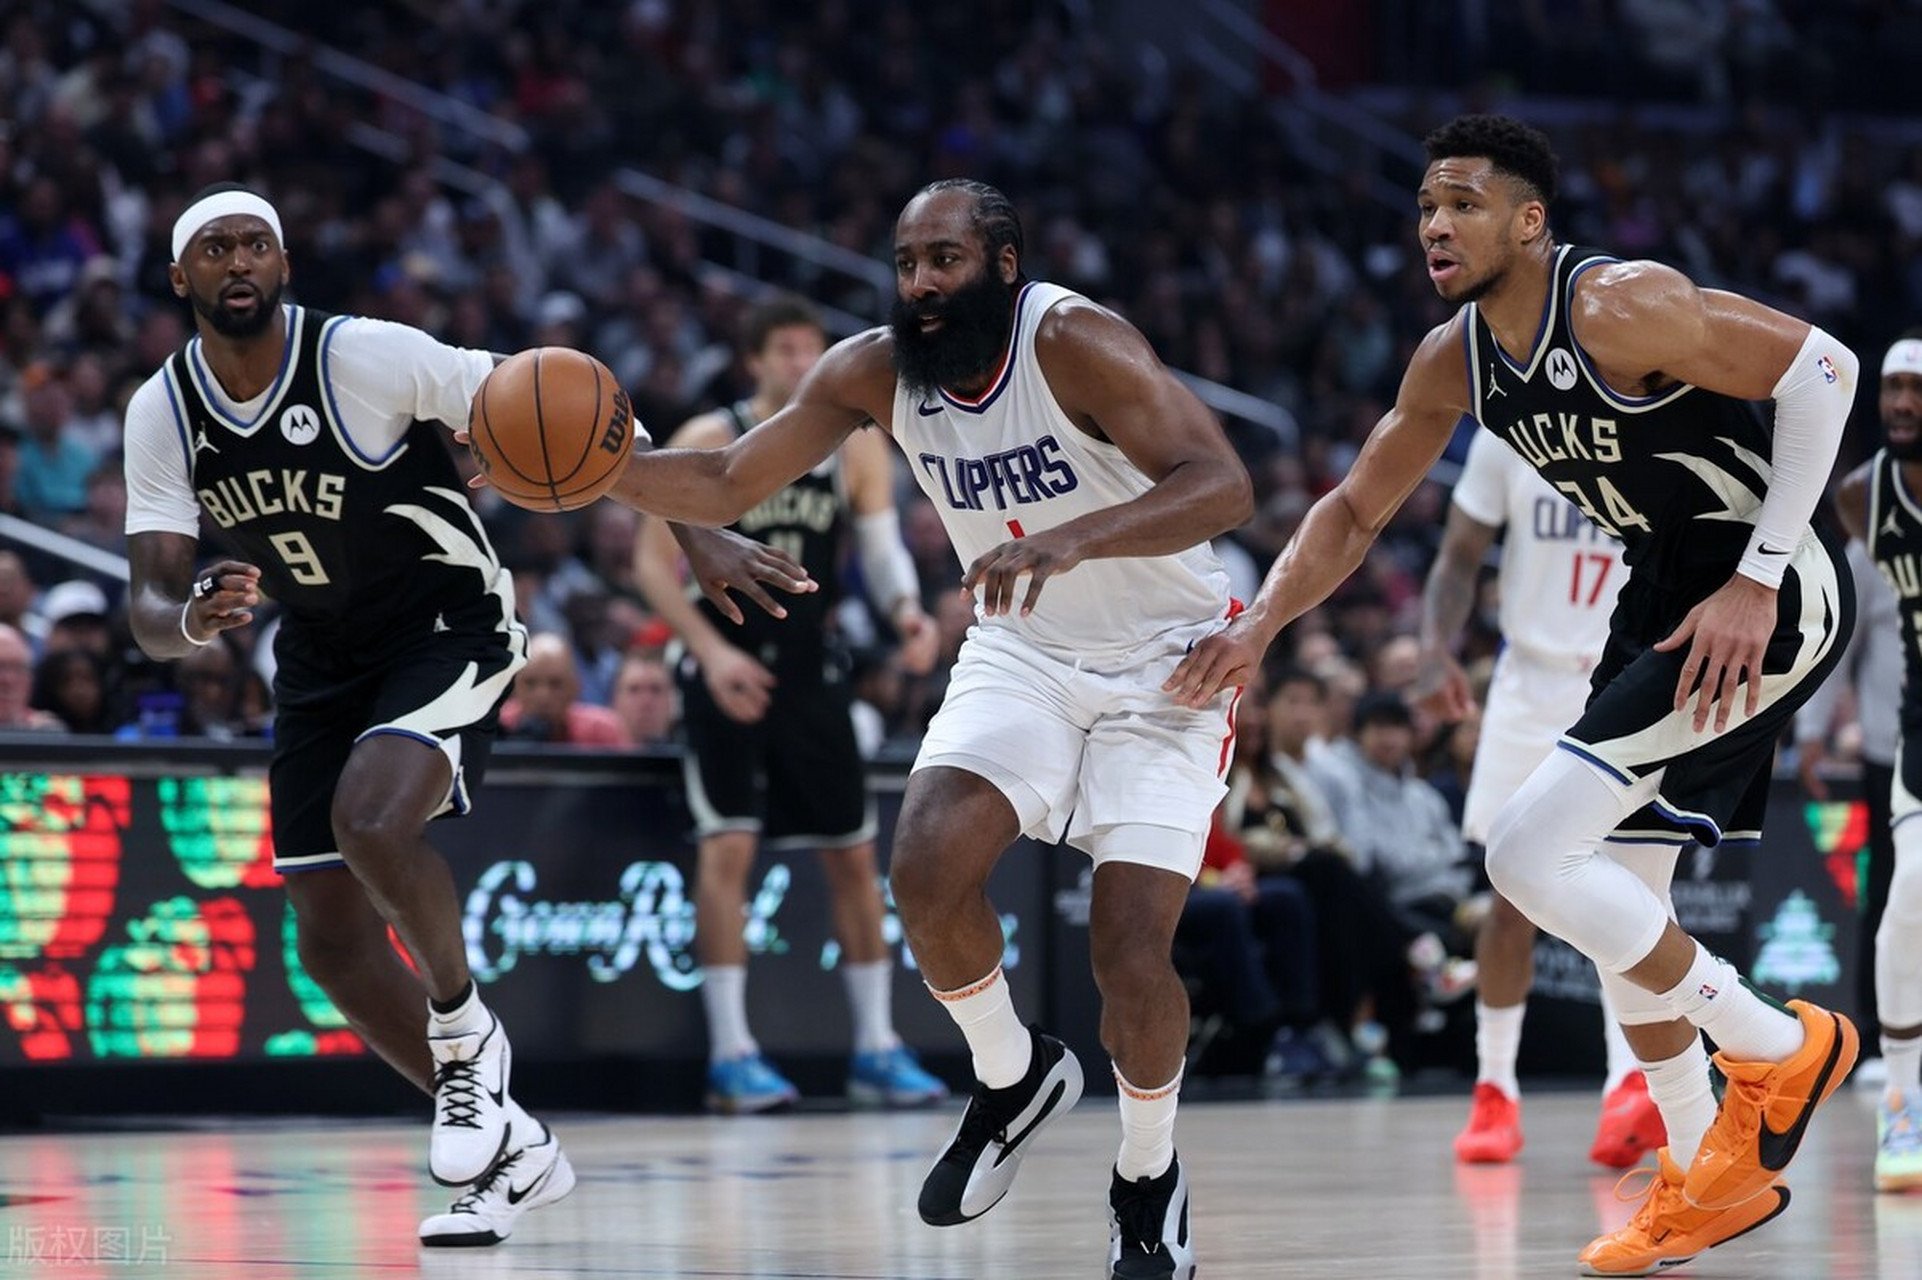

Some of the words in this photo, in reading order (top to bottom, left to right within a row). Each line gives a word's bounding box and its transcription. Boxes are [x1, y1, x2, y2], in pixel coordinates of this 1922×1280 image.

[1508, 412, 1623, 469] UCKS
[198, 469, 346, 529] BUCKS
[1554, 475, 1653, 537] 34
[268, 531, 331, 586] 9
[1569, 551, 1614, 607] 17
